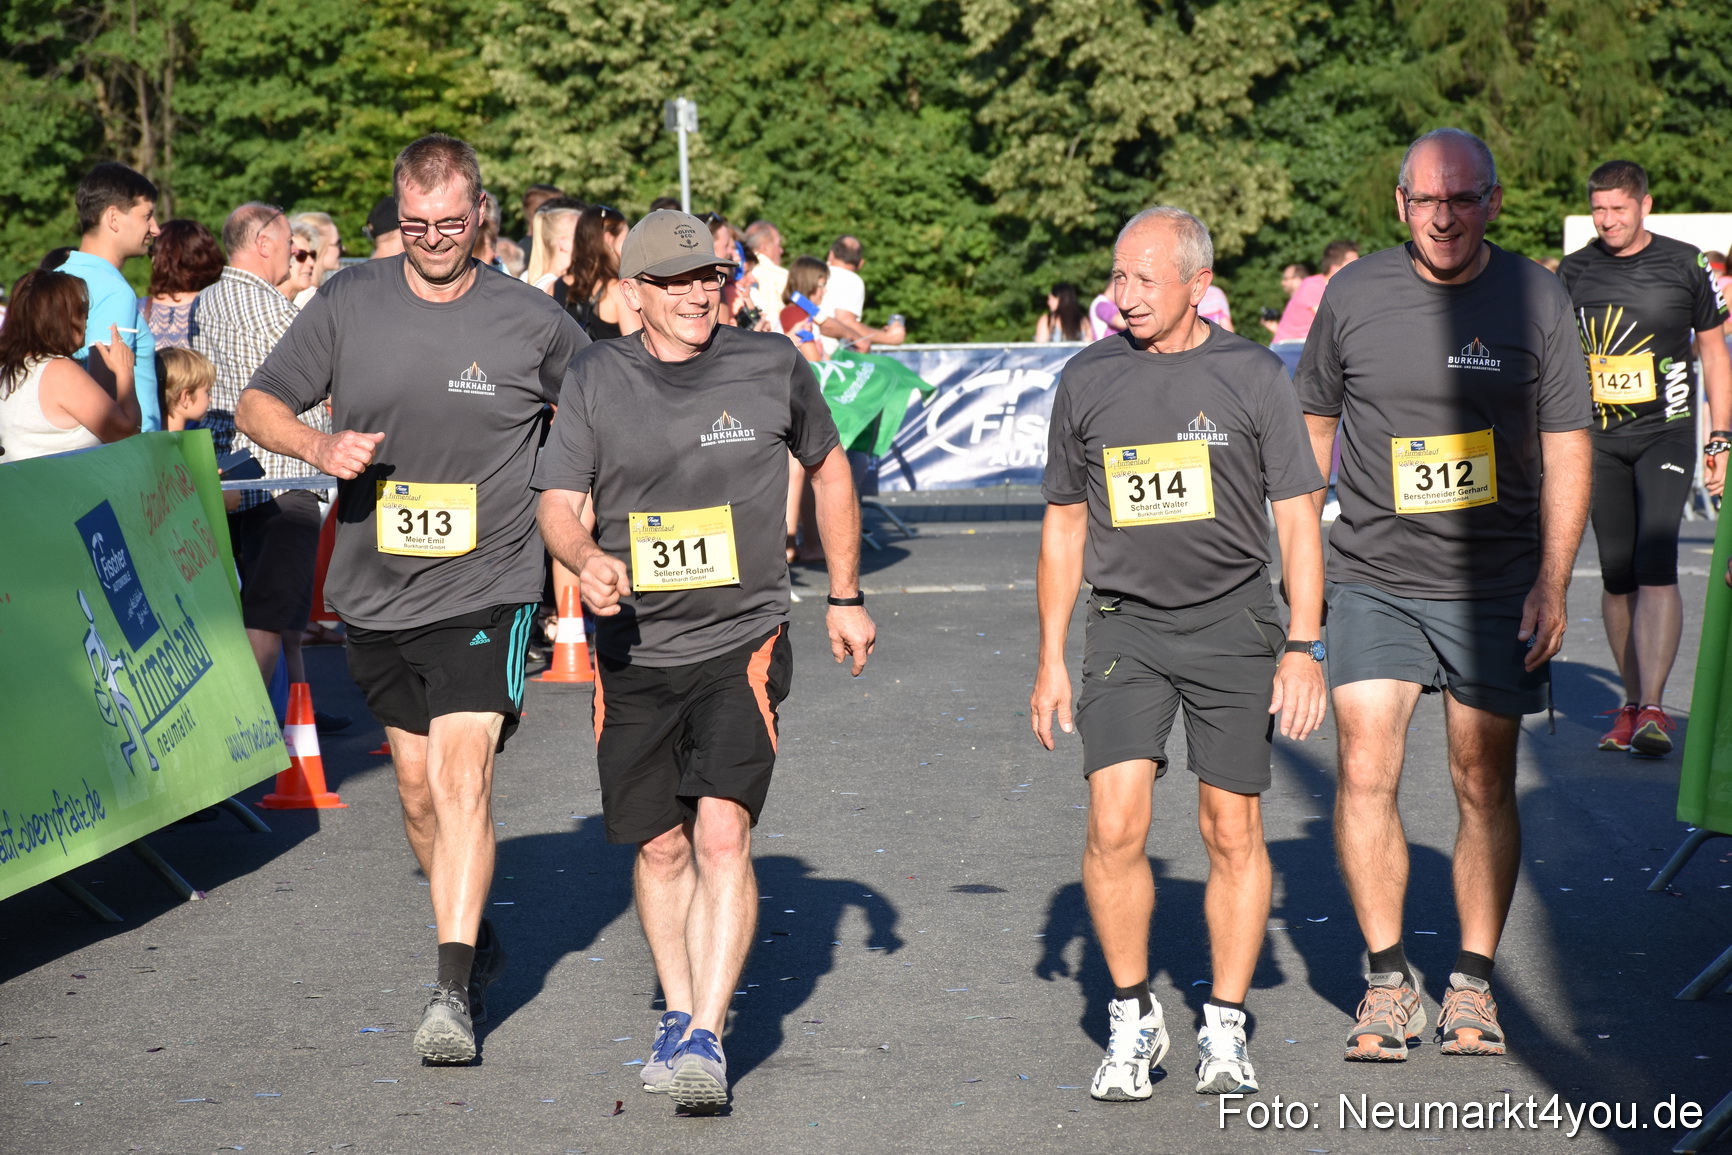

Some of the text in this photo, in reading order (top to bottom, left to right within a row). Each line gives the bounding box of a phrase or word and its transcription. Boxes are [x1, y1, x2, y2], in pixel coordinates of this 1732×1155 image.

[1448, 356, 1501, 367] BURKHARDT
[448, 380, 496, 392] BURKHARDT
[1598, 372, 1642, 389] 1421
[700, 429, 755, 442] BURKHARDT
[970, 406, 1049, 445] Fis
[1177, 432, 1228, 441] BURKHARDT
[1128, 471, 1186, 502] 314
[1415, 460, 1474, 491] 312
[1404, 485, 1488, 500] Berschneider Gerhard
[1130, 501, 1188, 512] Schardt Walter
[397, 509, 452, 536] 313
[652, 538, 707, 568] 311
[100, 548, 127, 581] Fischer
[654, 566, 714, 577] Sellerer Roland
[119, 593, 212, 723] firmenlauf
[156, 703, 196, 758] neumarkt
